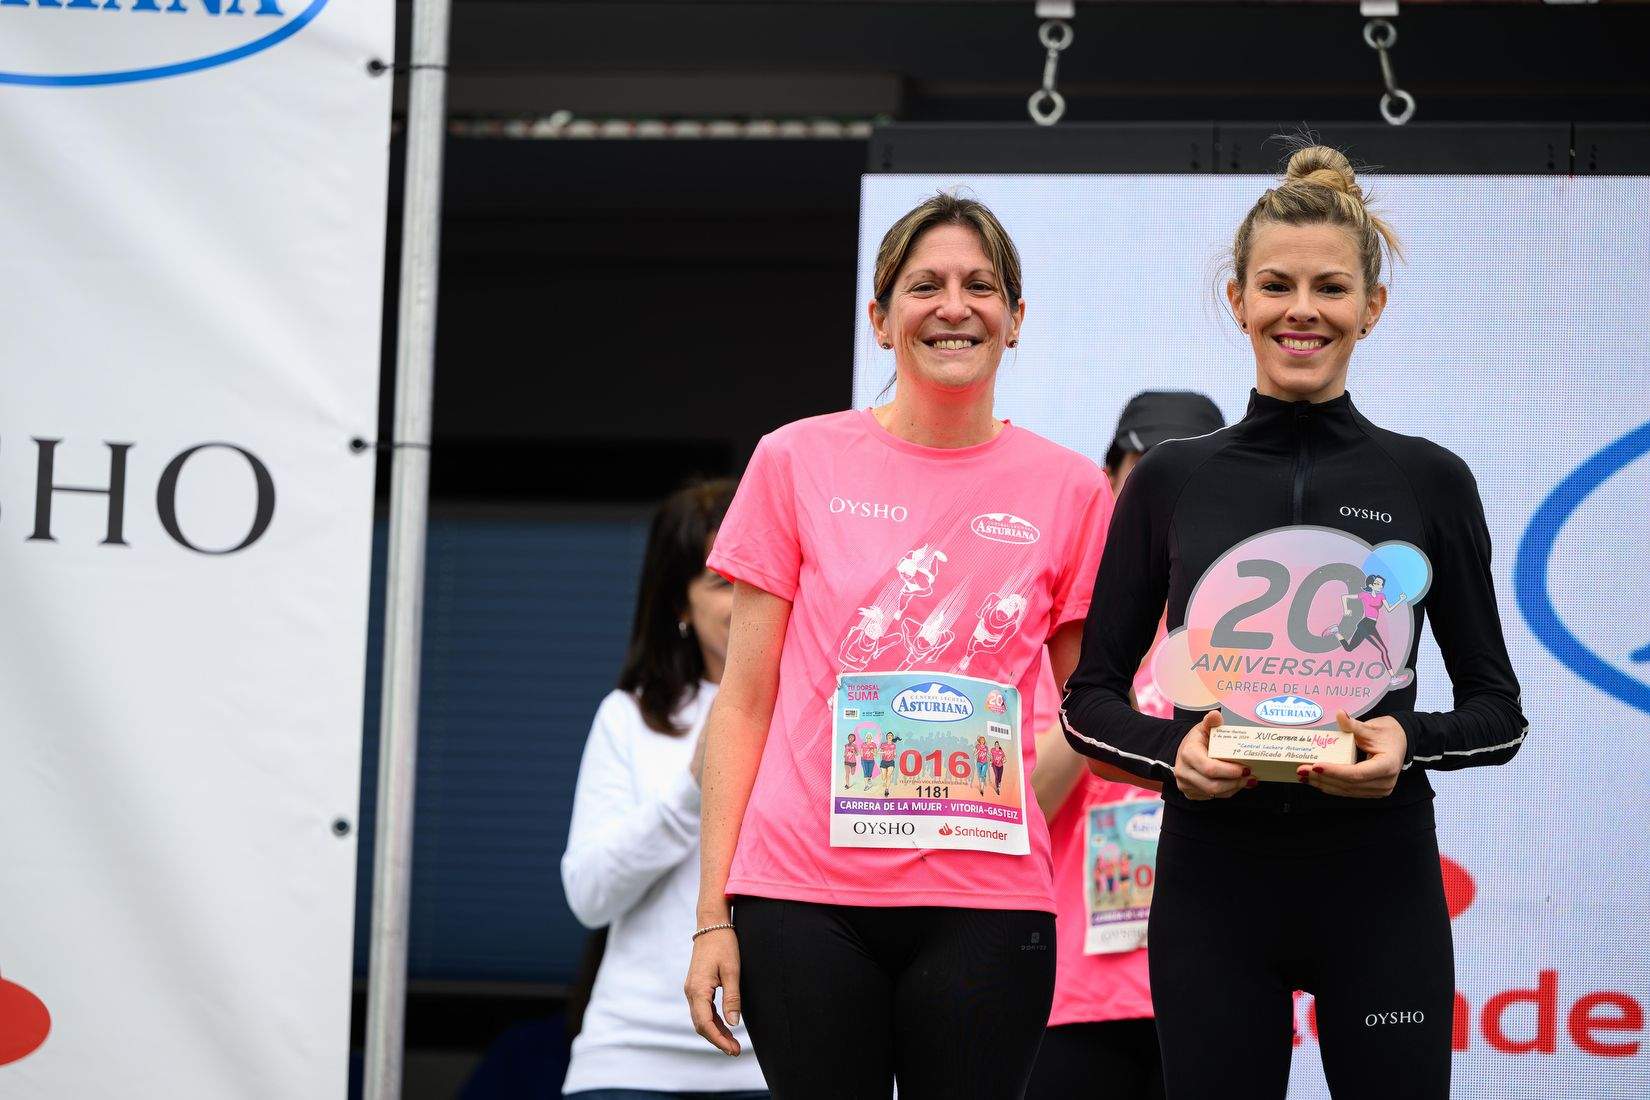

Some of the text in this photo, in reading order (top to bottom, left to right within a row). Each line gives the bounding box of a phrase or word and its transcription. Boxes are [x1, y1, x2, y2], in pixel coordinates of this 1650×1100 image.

[0, 435, 276, 556] HO
[829, 496, 908, 522] OYSHO
[1339, 506, 1392, 524] OYSHO
[976, 519, 1037, 541] ASTURIANA
[1210, 558, 1368, 654] 20
[1190, 653, 1387, 680] ANIVERSARIO
[847, 691, 880, 701] SUMA
[1216, 679, 1372, 698] CARRERA DE LA MUJER
[897, 696, 969, 715] ASTURIANA
[1259, 704, 1318, 718] ASTURIANA
[1311, 733, 1340, 749] Mujer
[899, 749, 972, 779] 016
[915, 785, 949, 798] 1181
[840, 800, 1018, 820] CARRERA DE LA MUJER VITORIA-GASTEIZ
[852, 821, 1008, 841] OYSHO Santander
[1365, 1010, 1425, 1027] OYSHO
[1452, 968, 1646, 1059] de
